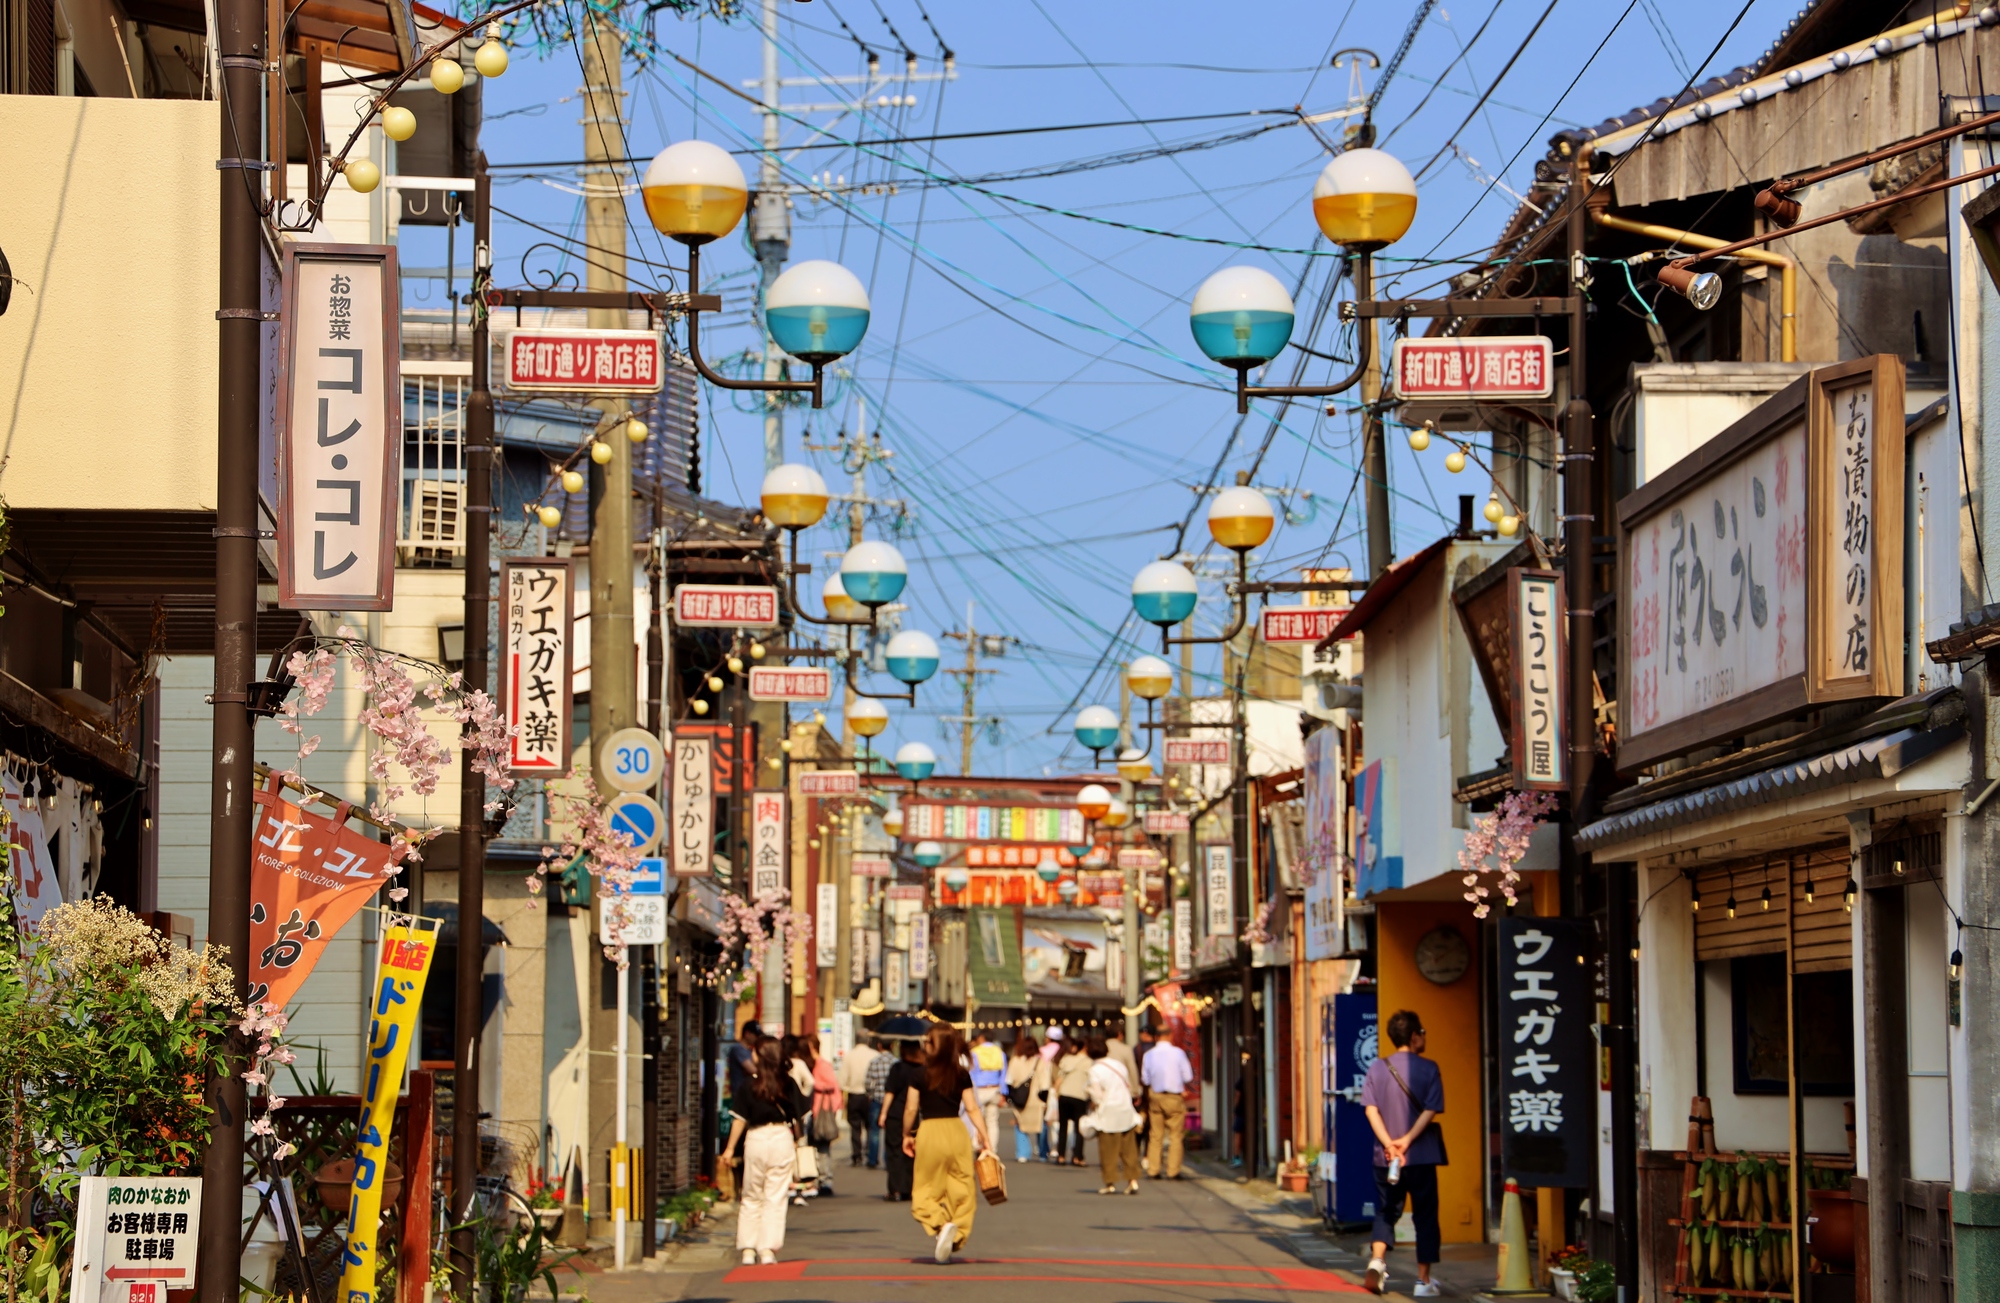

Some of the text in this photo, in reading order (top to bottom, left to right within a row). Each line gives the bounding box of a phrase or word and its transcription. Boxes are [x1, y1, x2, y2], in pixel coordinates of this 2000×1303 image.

[329, 274, 351, 341] お惣菜
[516, 341, 653, 380] 新町通り商店街
[1405, 350, 1541, 387] 新町通り商店街
[313, 347, 362, 581] コレ・コレ
[1843, 391, 1868, 671] お漬物の店
[683, 594, 772, 619] 新町通り商店街
[525, 569, 562, 752] ウエガキ薬
[1528, 586, 1551, 776] こうこう屋
[616, 747, 649, 774] 30
[680, 742, 703, 868] かしゅ・かしゅ
[757, 797, 779, 892] 肉の金岡
[257, 852, 346, 892] KORE'S COLLEZIONI
[1509, 929, 1564, 1133] ウエガキ薬
[108, 1186, 191, 1205] 肉のかなおか
[107, 1212, 188, 1234] お客様専用
[125, 1238, 175, 1260] 駐車場
